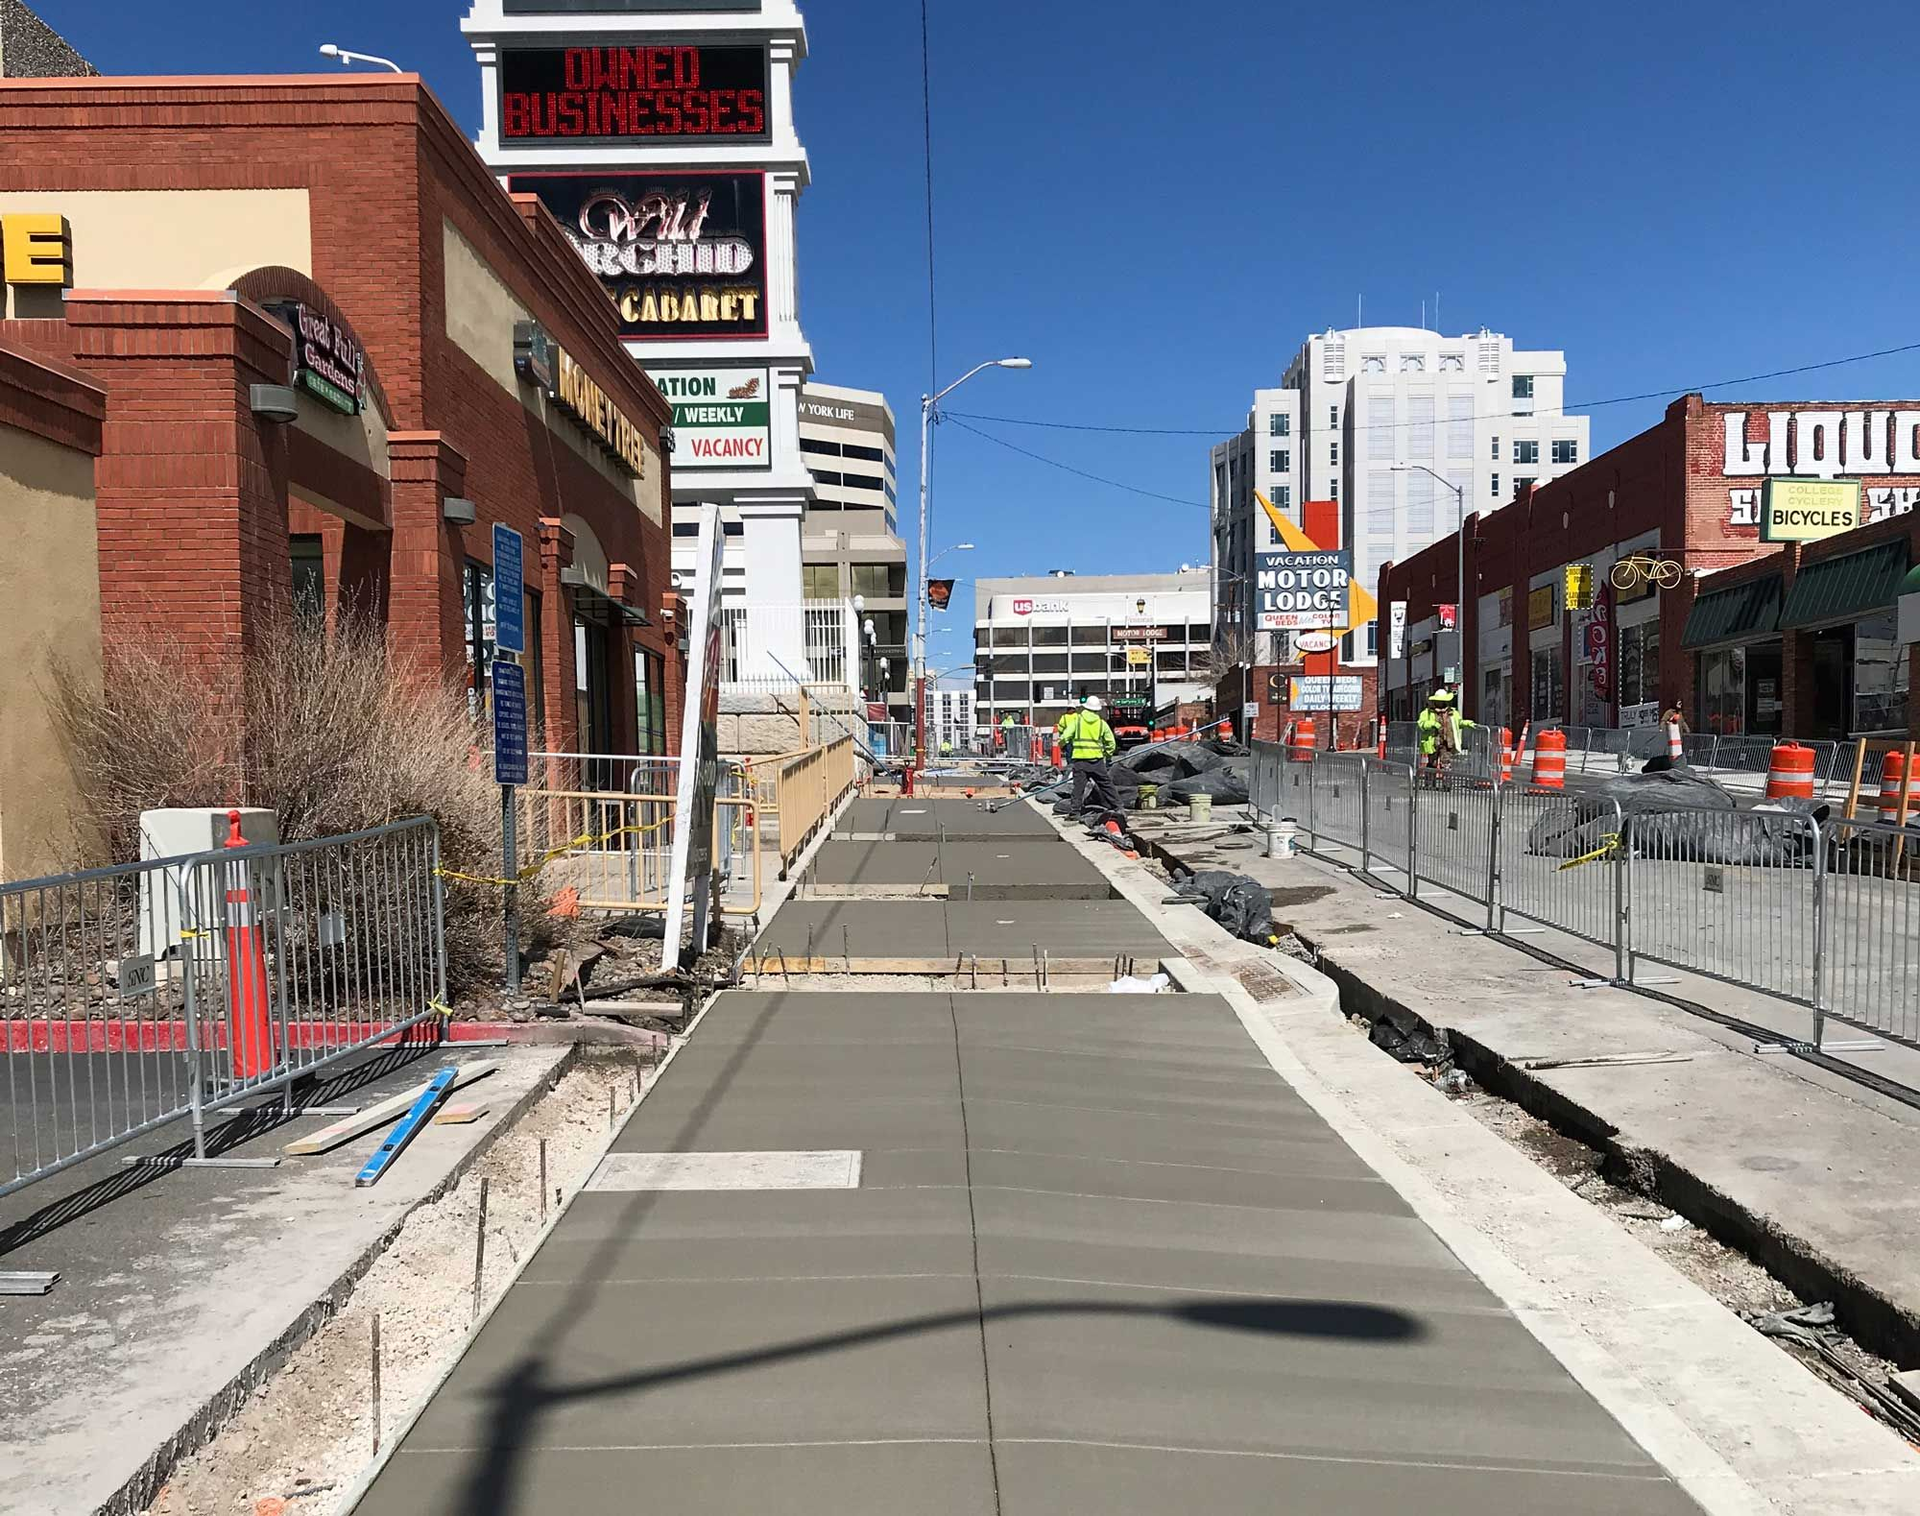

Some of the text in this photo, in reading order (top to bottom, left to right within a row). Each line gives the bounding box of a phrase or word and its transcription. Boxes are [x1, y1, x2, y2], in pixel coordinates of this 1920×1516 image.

[565, 46, 700, 90] OWNED
[504, 90, 763, 136] BUSINESSES
[579, 187, 713, 241] Wild
[561, 227, 753, 276] RCHID
[619, 286, 760, 323] CABARET
[298, 303, 357, 376] Great Full
[305, 343, 355, 395] Gardens
[558, 345, 645, 476] MONEYTREE
[684, 406, 744, 424] WEEKLY
[807, 403, 834, 418] YORK
[835, 407, 855, 421] LIFE
[691, 437, 764, 458] VACANCY
[1788, 486, 1844, 496] COLLEGE
[1788, 496, 1844, 507] CYCLERY
[1772, 510, 1853, 527] BICYCLES
[1266, 555, 1339, 567] VACATION
[1258, 569, 1348, 589] MOTOR
[1264, 591, 1341, 611] LODGE
[1264, 614, 1299, 622] QUEEN
[1301, 685, 1321, 694] COLOR
[1336, 676, 1358, 684] BEDS
[1304, 694, 1325, 703] DAILY
